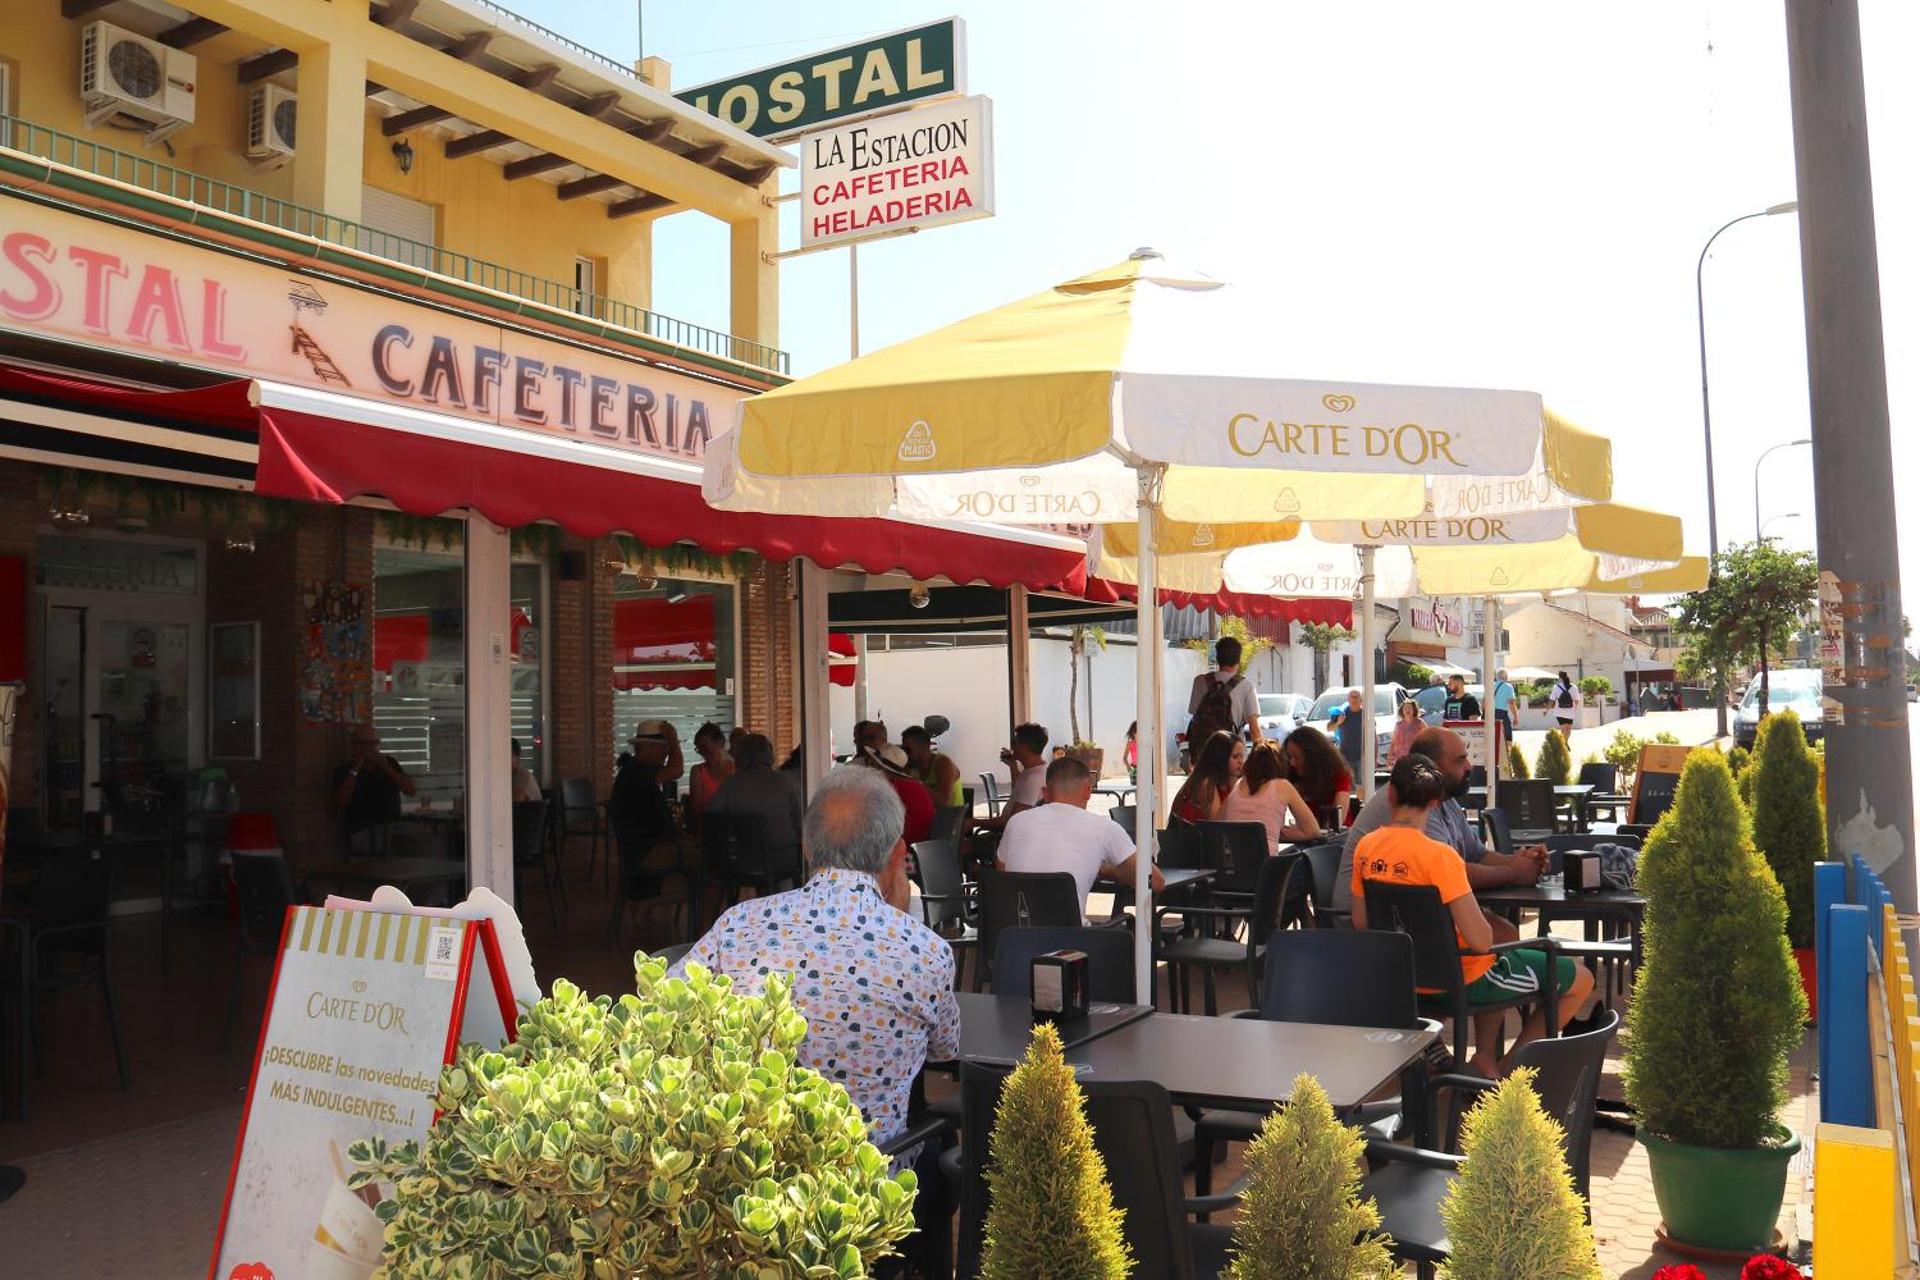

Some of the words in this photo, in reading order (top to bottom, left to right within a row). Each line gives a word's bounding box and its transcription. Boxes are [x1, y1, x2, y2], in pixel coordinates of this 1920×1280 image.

[814, 133, 845, 169] LA
[850, 119, 968, 171] ESTACION
[813, 155, 969, 206] CAFETERIA
[813, 187, 973, 237] HELADERIA
[372, 325, 712, 456] CAFETERIA
[1228, 413, 1350, 457] CARTE
[1362, 424, 1469, 467] D'OR
[307, 991, 360, 1021] CARTE
[363, 1002, 409, 1035] D'OR
[264, 1046, 333, 1074] ¡DESCUBRE
[335, 1056, 355, 1078] las
[358, 1067, 436, 1093] novedades
[270, 1078, 300, 1102] MÁS
